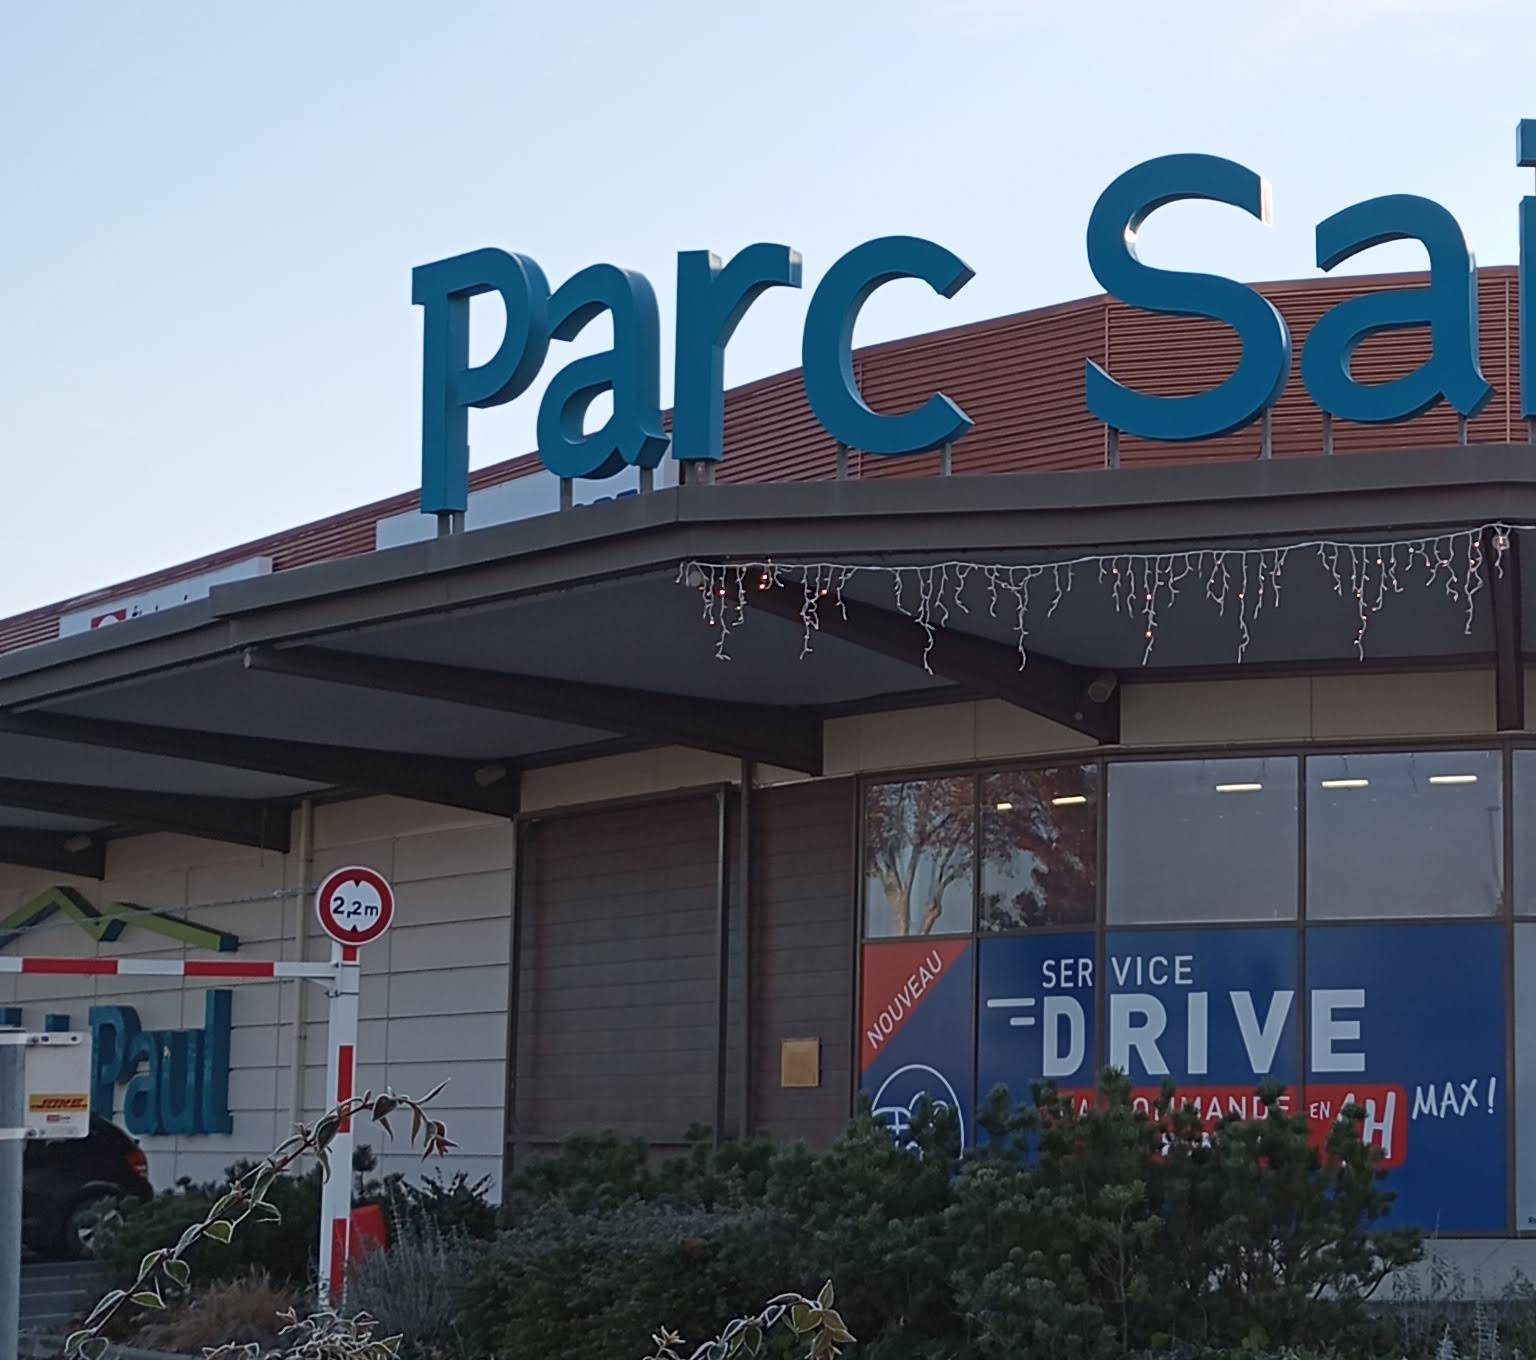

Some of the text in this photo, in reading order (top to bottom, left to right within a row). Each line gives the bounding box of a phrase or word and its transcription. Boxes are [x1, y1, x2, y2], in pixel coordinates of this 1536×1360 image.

[866, 949, 944, 1049] NOUVEAU
[1042, 955, 1193, 988] SERVICE
[89, 989, 233, 1136] Paul
[1042, 989, 1366, 1077] DRIVE
[1310, 1101, 1331, 1120] EN
